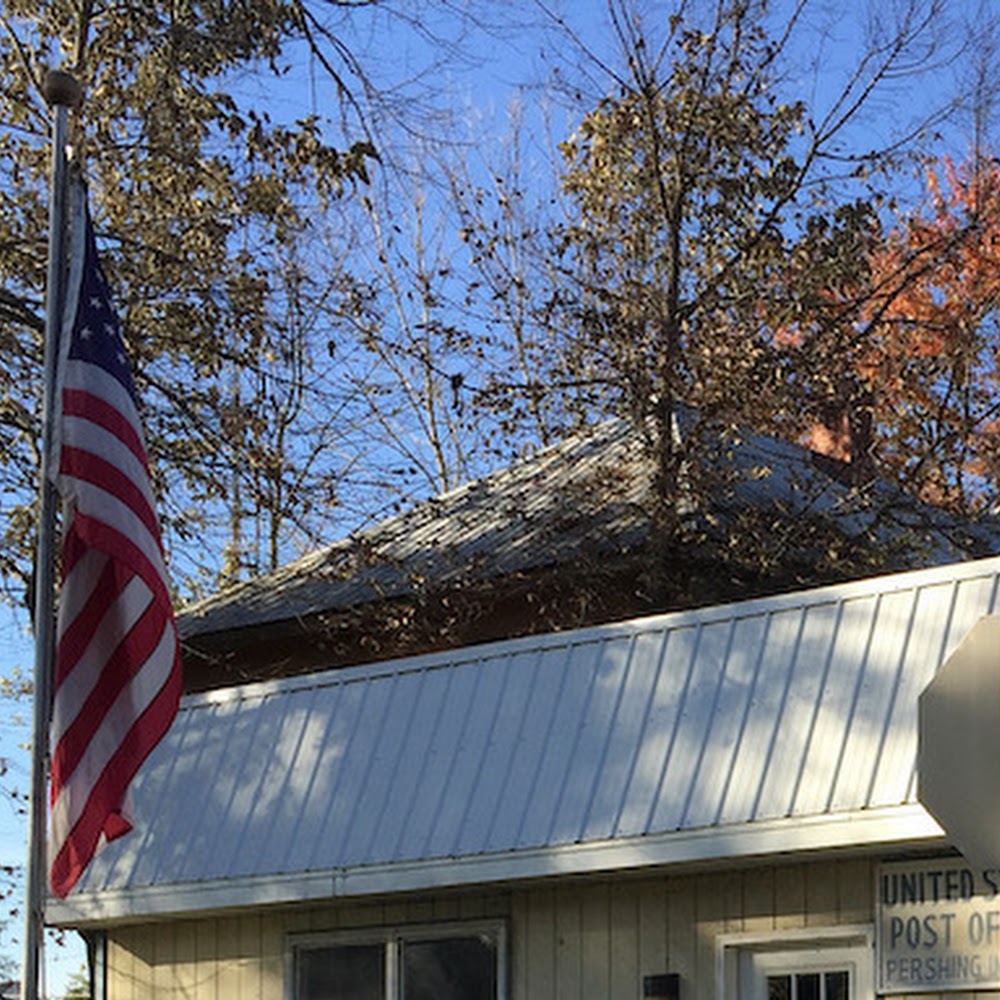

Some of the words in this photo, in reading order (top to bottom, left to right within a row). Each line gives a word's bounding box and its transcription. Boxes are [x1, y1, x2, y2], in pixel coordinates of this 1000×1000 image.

[881, 869, 974, 904] UNITED
[891, 914, 955, 950] POST
[886, 954, 982, 981] PERSHING
